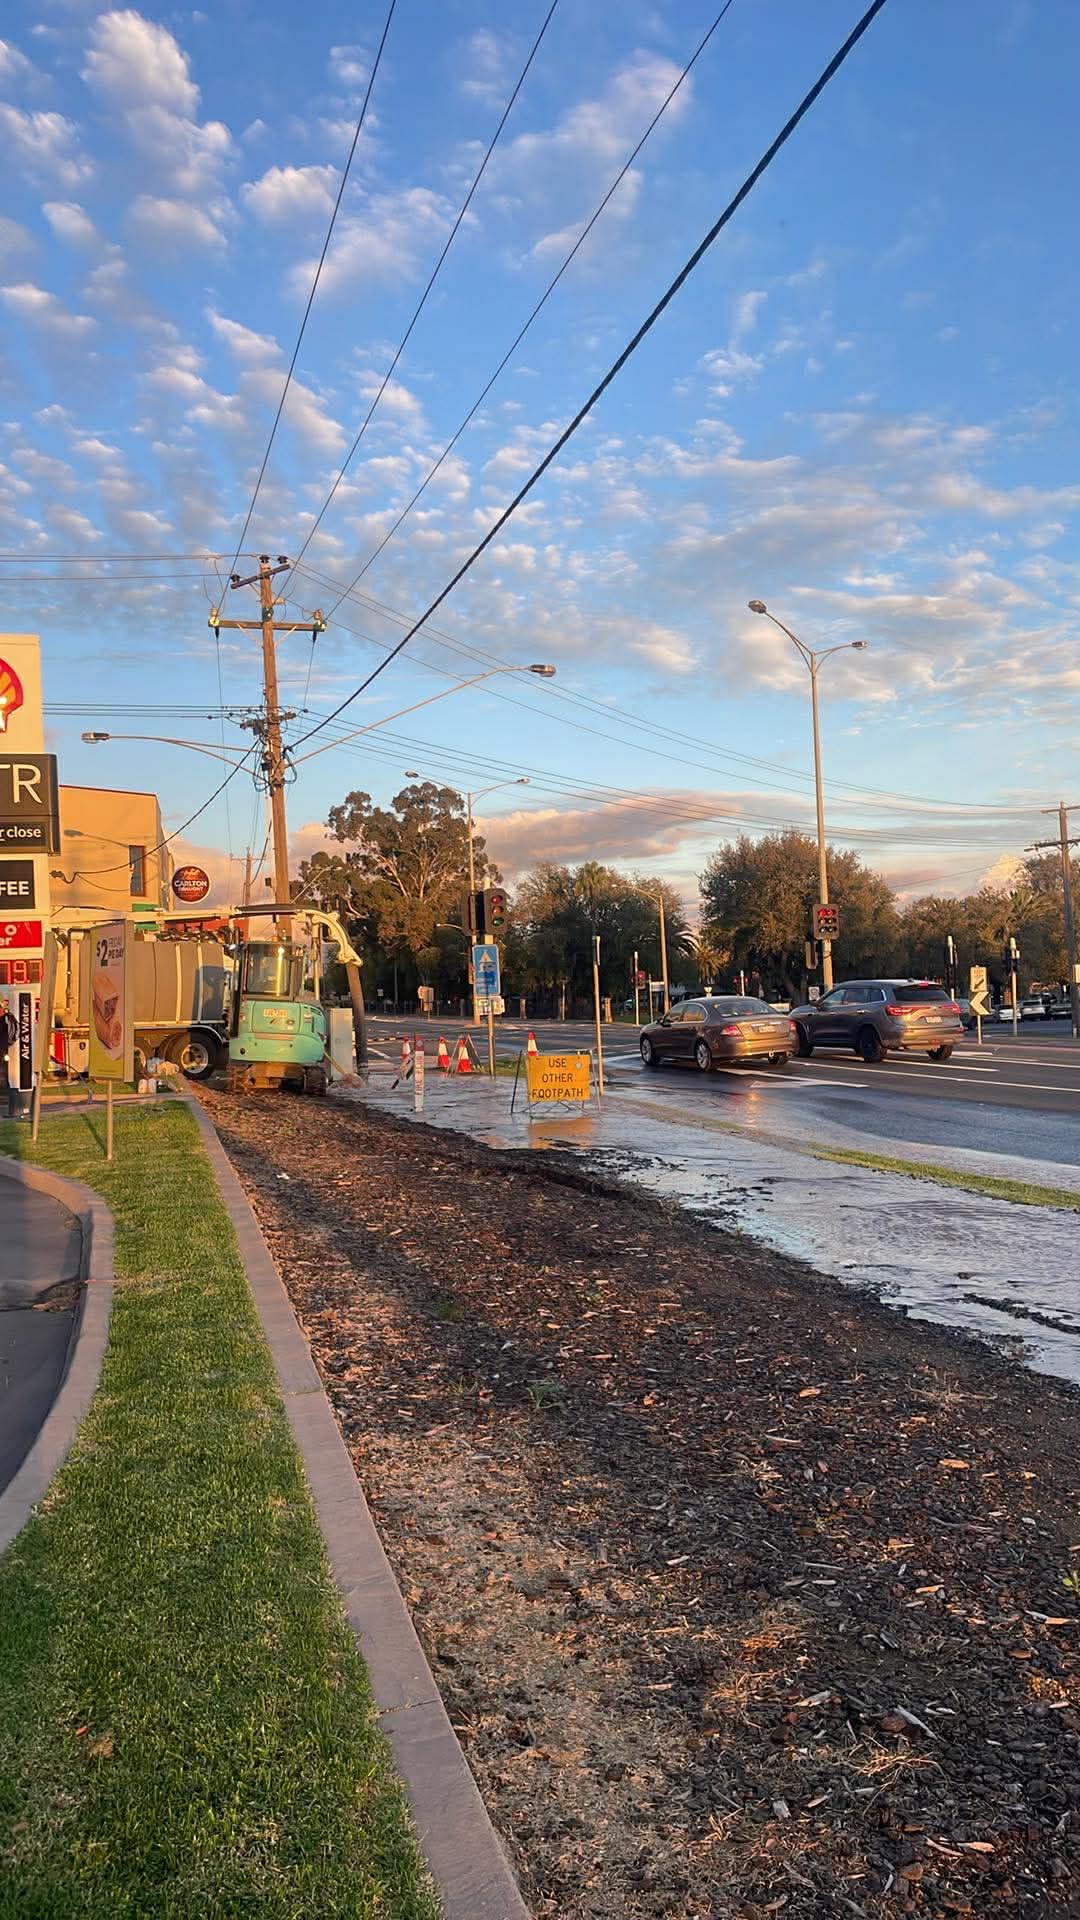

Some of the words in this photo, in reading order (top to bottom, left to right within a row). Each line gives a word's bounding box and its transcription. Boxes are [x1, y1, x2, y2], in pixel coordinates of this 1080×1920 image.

[7, 826, 41, 837] close
[0, 881, 29, 895] FEE
[22, 1004, 30, 1034] Water
[22, 1034, 30, 1043] &
[22, 1044, 30, 1060] Air
[549, 1058, 567, 1068] USE
[542, 1073, 573, 1083] OTHER
[532, 1088, 583, 1099] FOOTPATH
